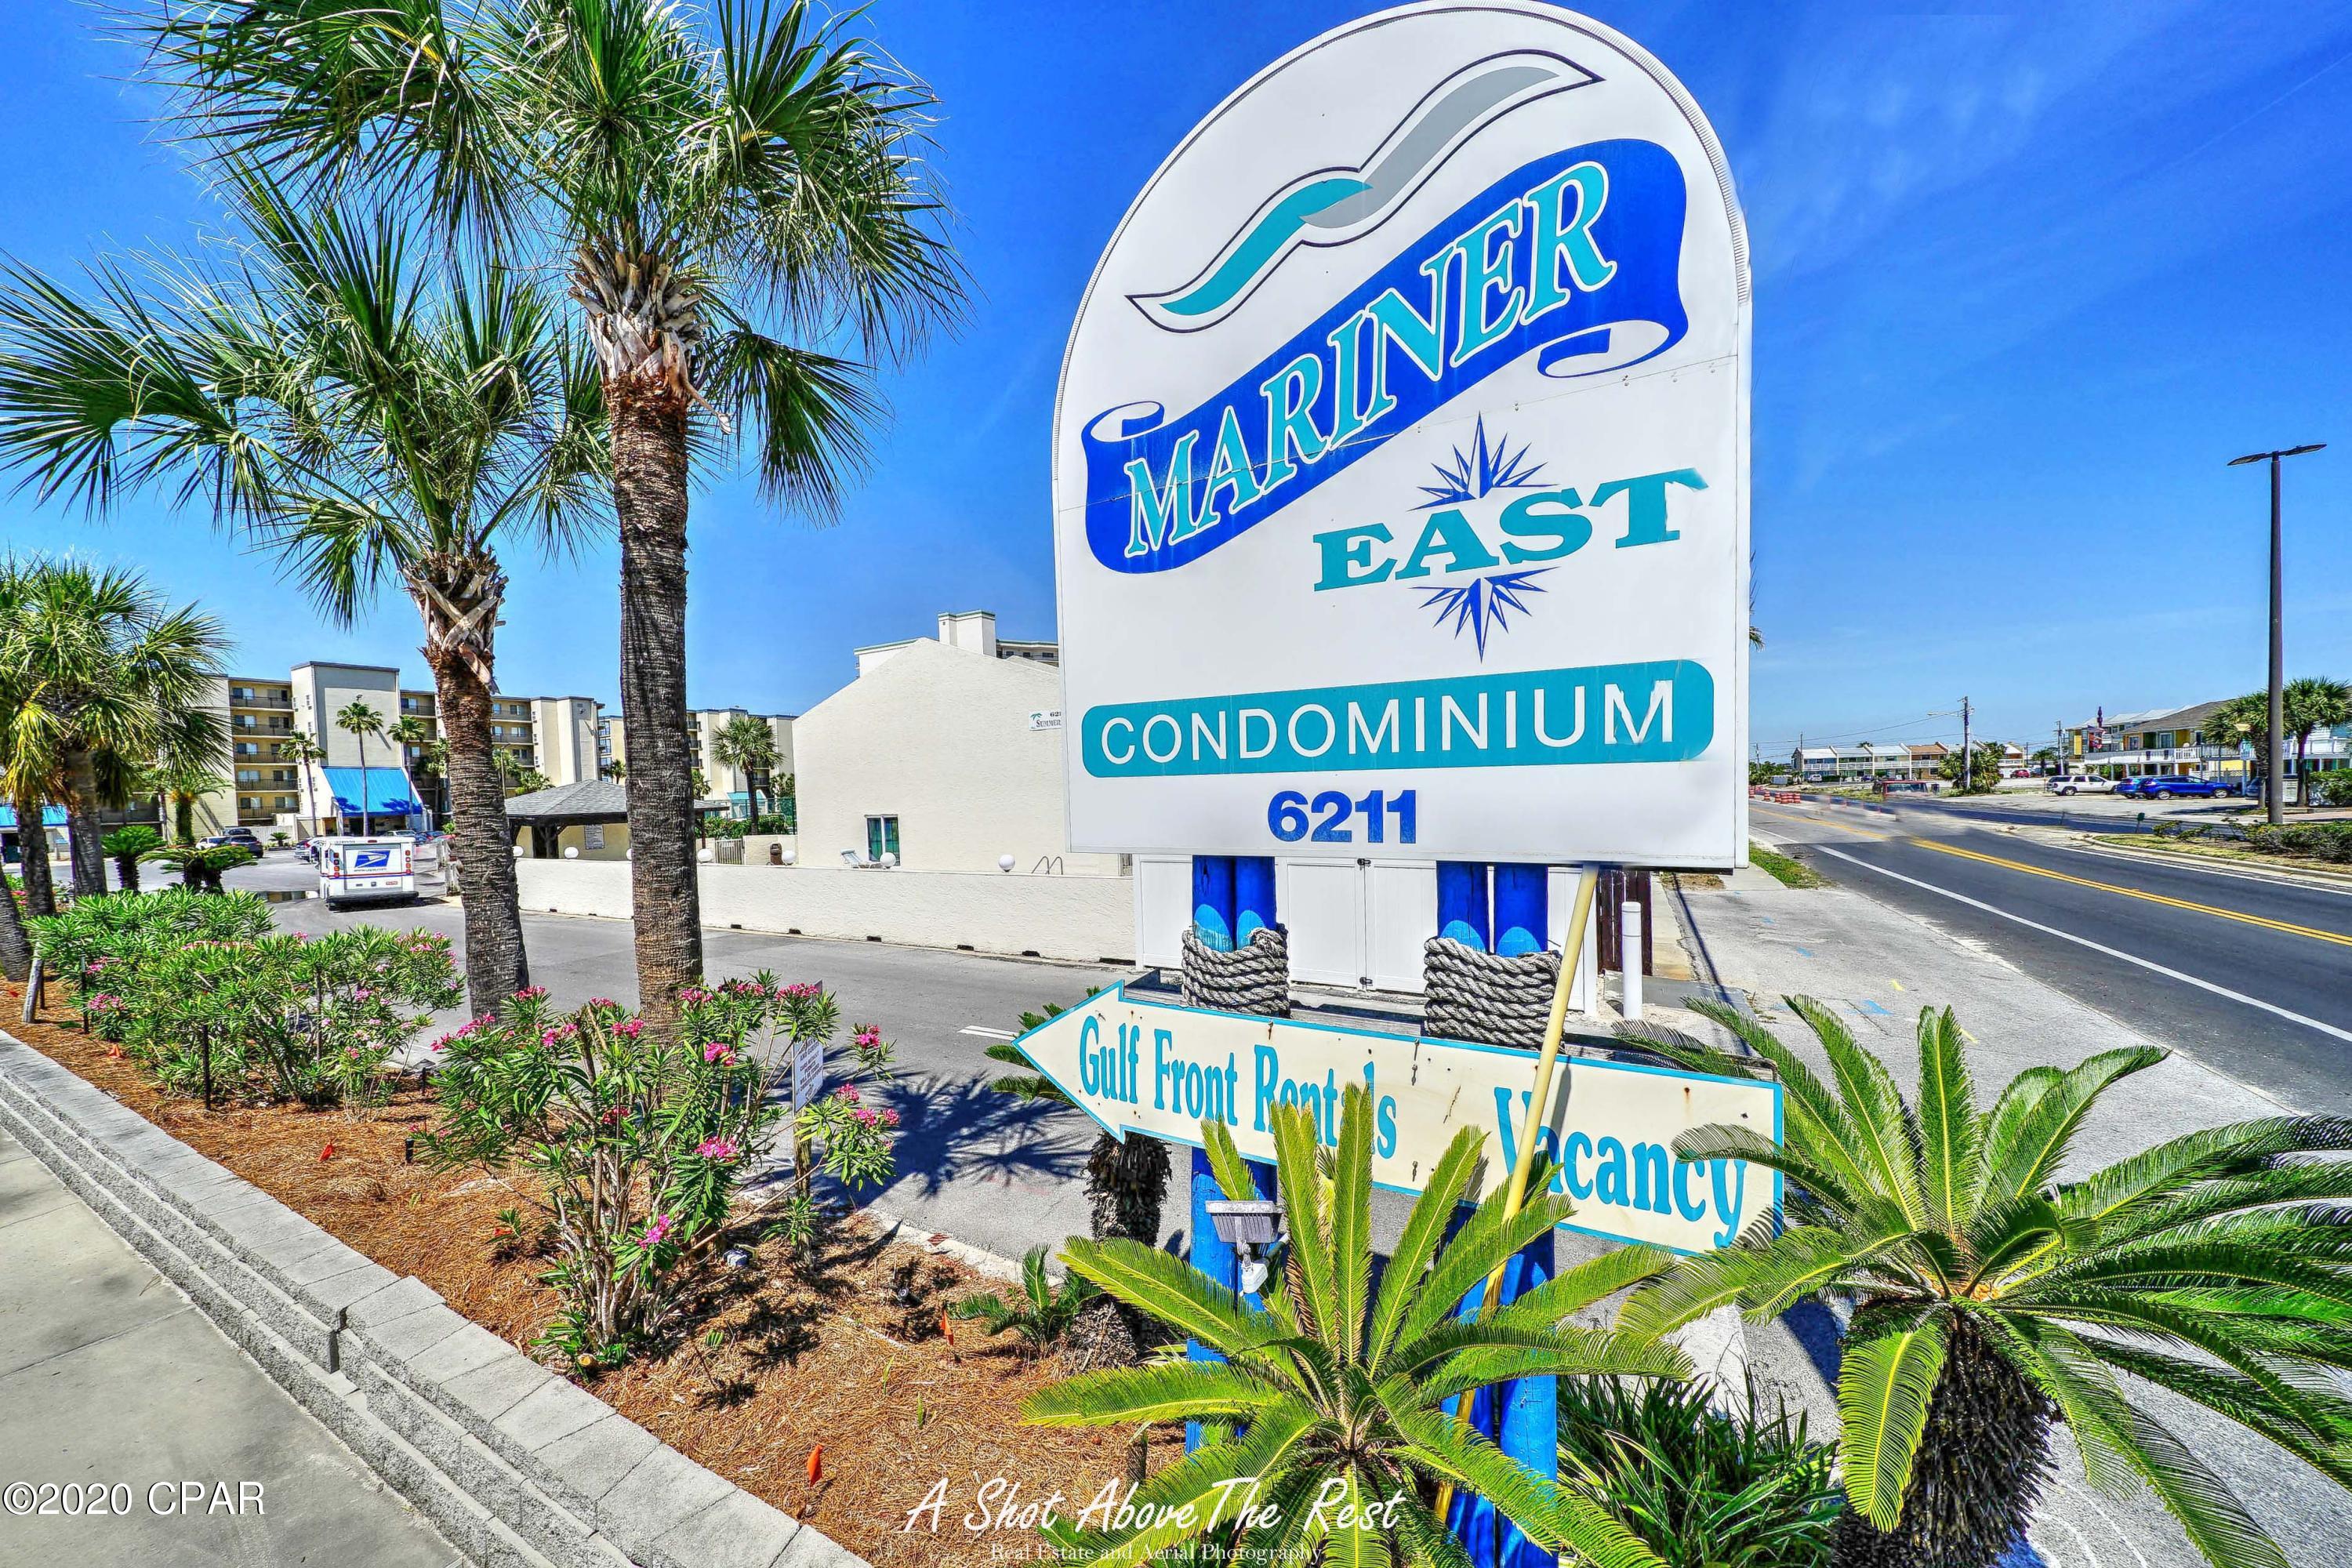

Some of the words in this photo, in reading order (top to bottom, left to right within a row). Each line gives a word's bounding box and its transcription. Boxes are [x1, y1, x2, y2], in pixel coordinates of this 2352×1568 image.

[1123, 160, 1617, 557] MARINER
[1313, 467, 1709, 592] EAST
[1101, 680, 1674, 764] CONDOMINIUM
[1267, 790, 1417, 844] 6211
[1080, 1015, 1140, 1104] Gulf
[1154, 1029, 1237, 1126] Front
